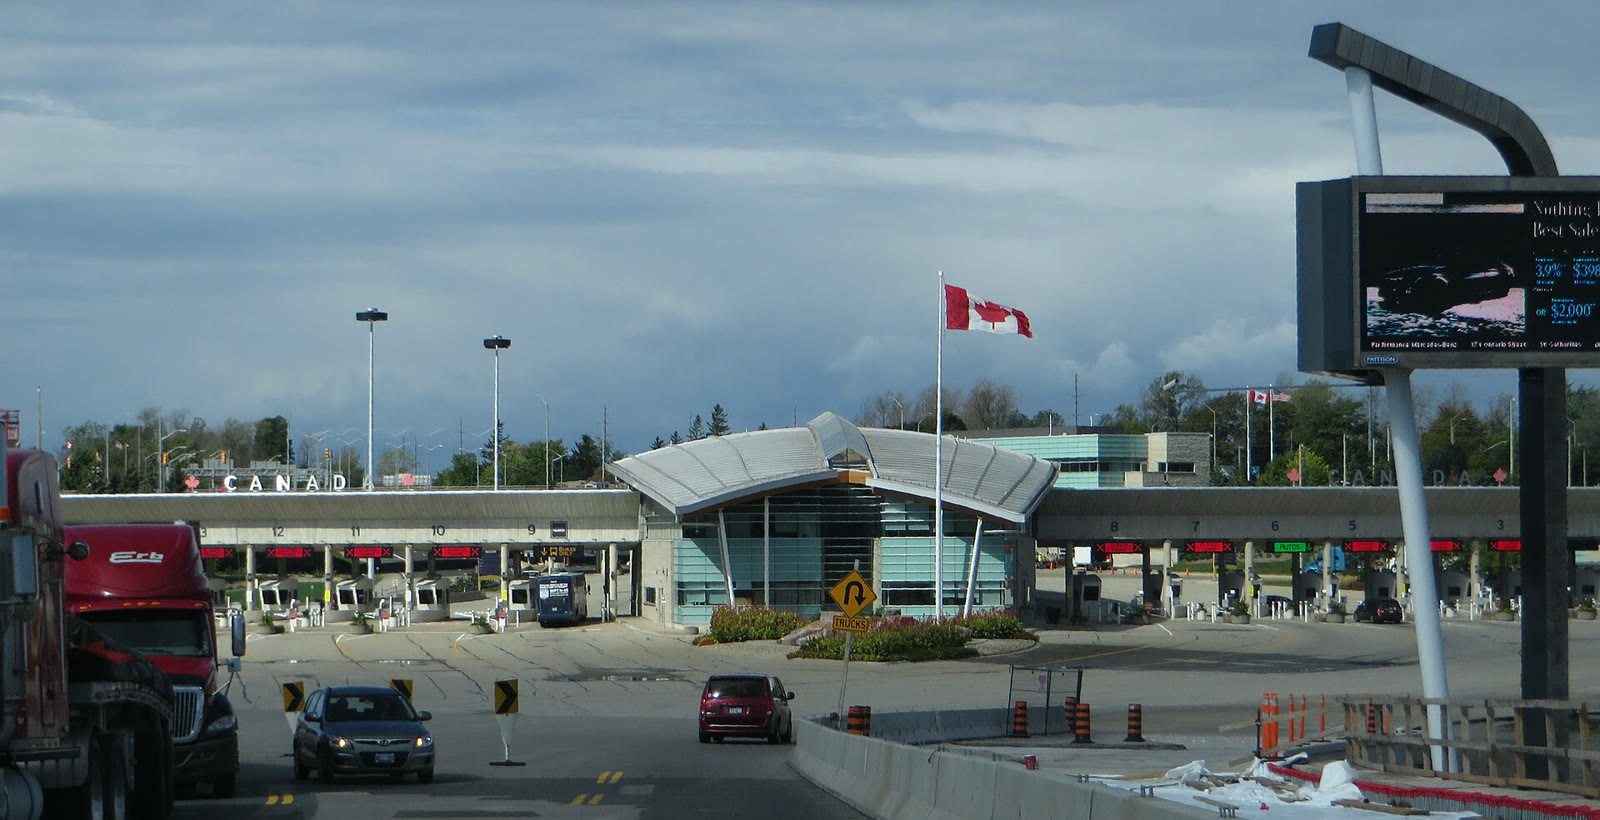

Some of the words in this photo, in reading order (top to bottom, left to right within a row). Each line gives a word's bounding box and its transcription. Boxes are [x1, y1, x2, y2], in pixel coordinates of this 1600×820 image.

[1533, 221, 1564, 238] Best
[223, 474, 375, 492] CANADA
[1328, 469, 1472, 486] CANDA
[528, 524, 536, 535] 9
[1111, 520, 1119, 532] 8
[1192, 521, 1200, 532] 7
[1271, 520, 1279, 531] 6
[1348, 520, 1357, 531] 5
[1496, 519, 1504, 530] 3
[272, 526, 284, 537] 12
[351, 526, 361, 537] 11
[431, 525, 445, 536] 10
[109, 551, 164, 563] Erb
[835, 618, 866, 629] TRUCKS
